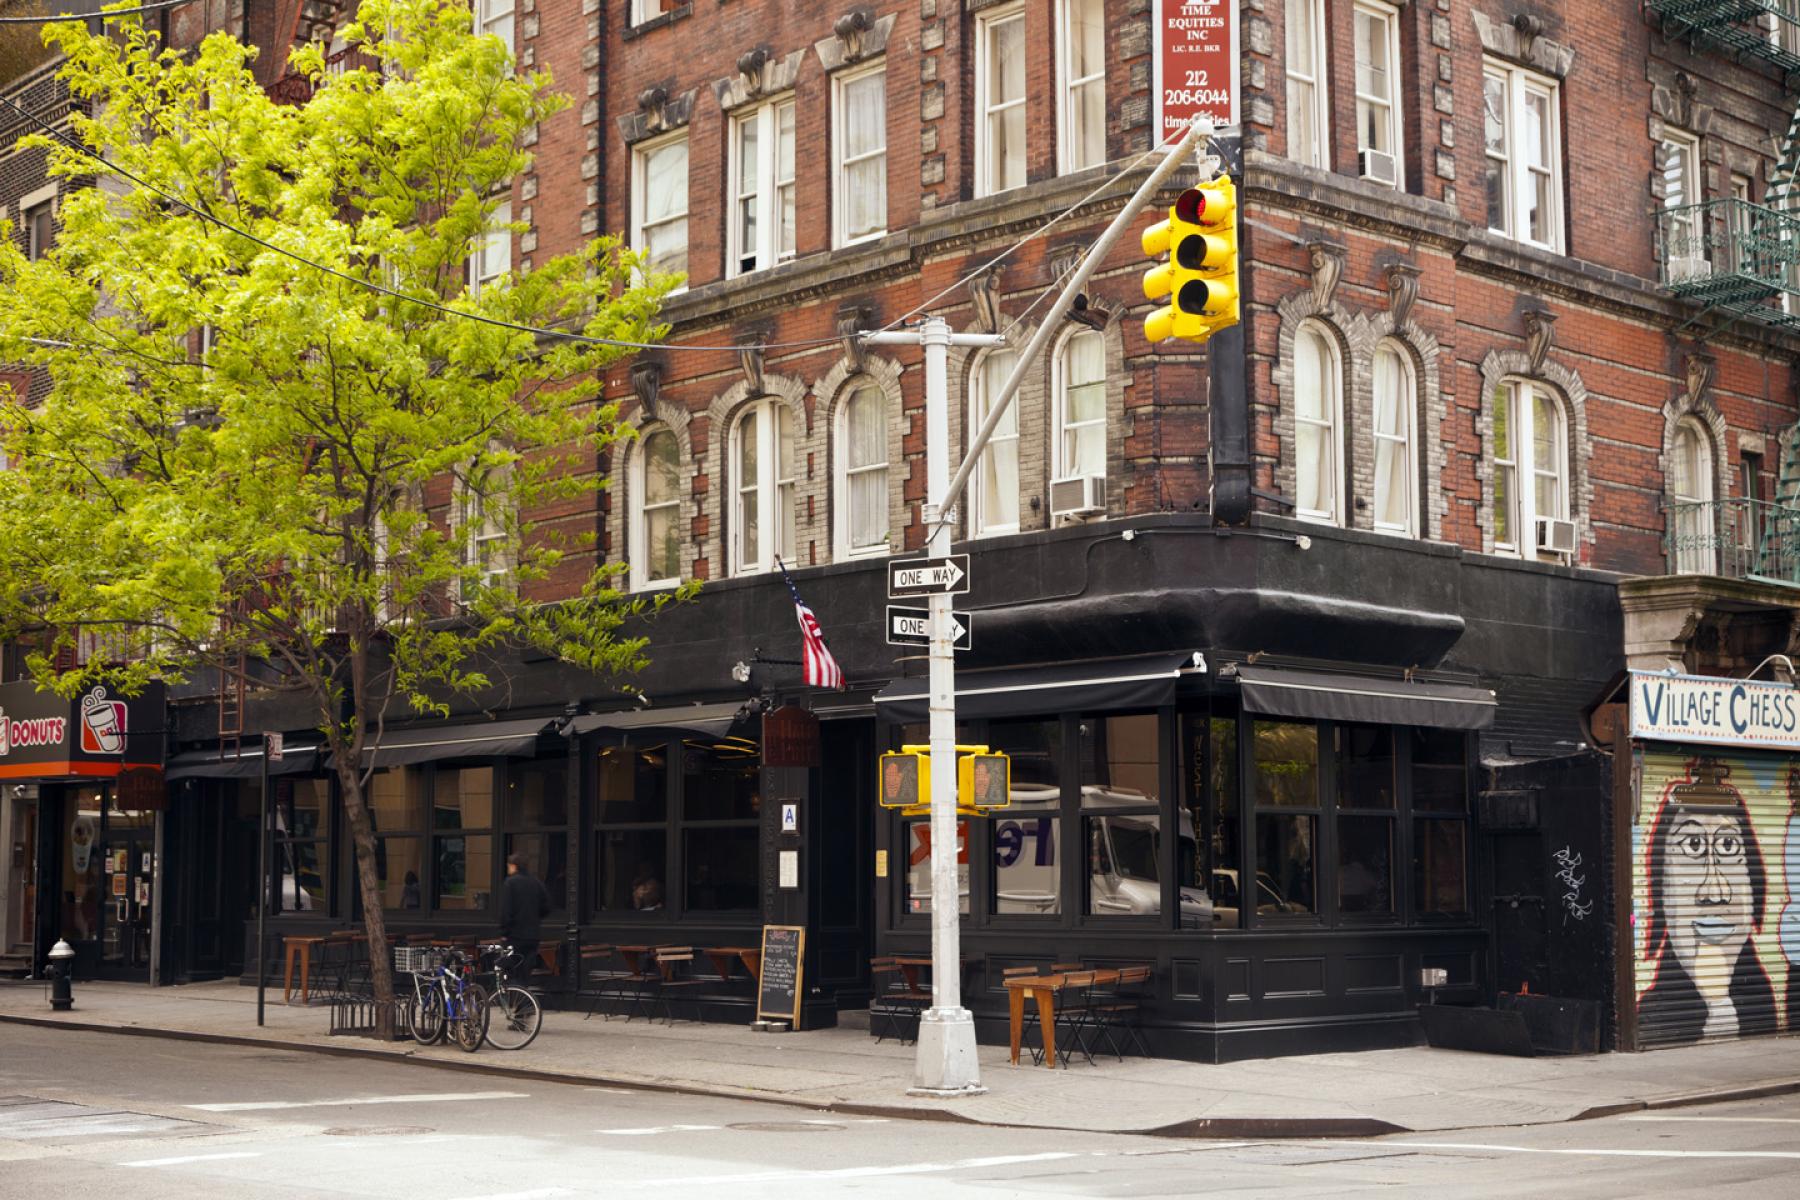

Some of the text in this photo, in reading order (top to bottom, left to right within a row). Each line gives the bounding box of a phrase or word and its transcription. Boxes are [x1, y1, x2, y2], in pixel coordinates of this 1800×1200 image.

[1181, 6, 1211, 15] TIME
[1168, 18, 1224, 29] EQUITIES
[1187, 30, 1208, 40] INC
[1185, 70, 1208, 86] 212
[1165, 89, 1229, 105] 206-6044
[900, 568, 955, 585] ONE WAY
[900, 619, 924, 634] ONE
[11, 717, 64, 747] DONUTS
[785, 808, 794, 823] A
